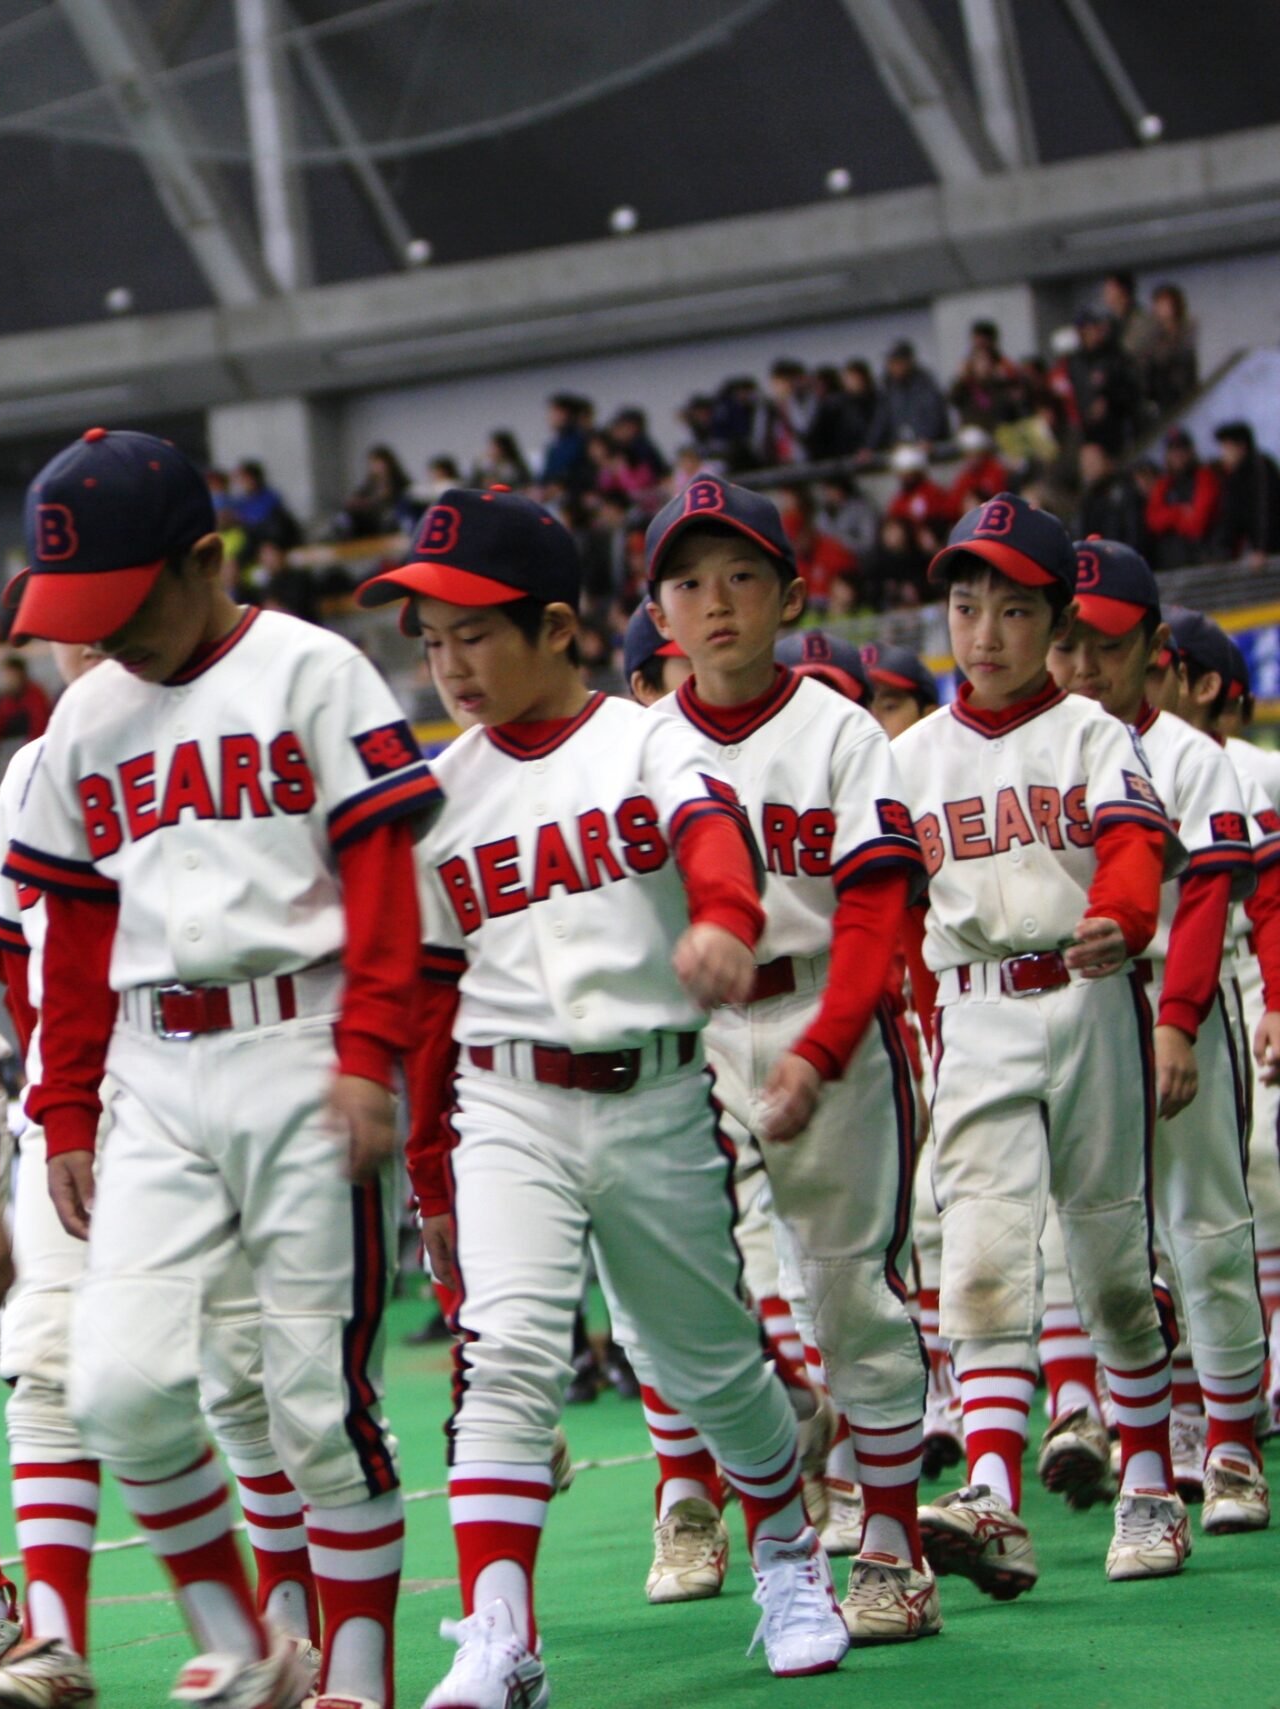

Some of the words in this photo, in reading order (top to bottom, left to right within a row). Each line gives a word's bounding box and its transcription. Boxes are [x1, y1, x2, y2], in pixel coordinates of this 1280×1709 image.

[684, 480, 724, 514] B
[972, 501, 1015, 535] B
[34, 504, 78, 561] B
[415, 505, 461, 554] B
[77, 731, 316, 862] BEARS
[914, 783, 1094, 879] BEARS
[437, 795, 669, 936] BEARS
